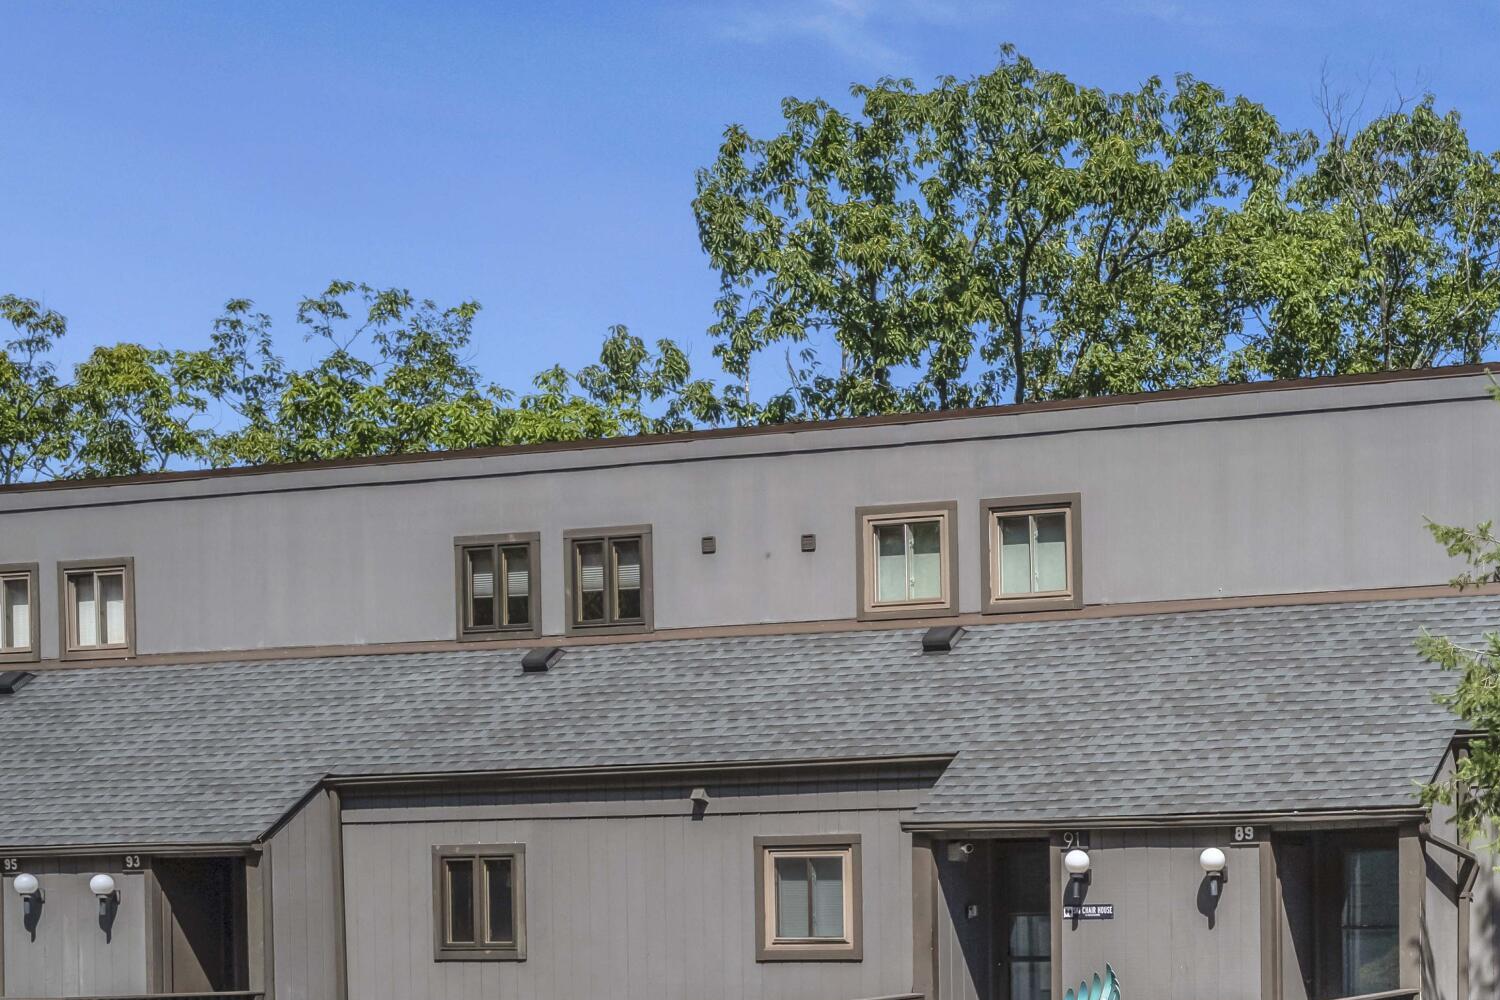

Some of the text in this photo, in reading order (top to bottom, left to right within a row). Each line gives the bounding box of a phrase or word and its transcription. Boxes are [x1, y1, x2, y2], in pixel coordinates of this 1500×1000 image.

[1063, 831, 1080, 849] 91
[1234, 826, 1254, 841] 89
[4, 858, 18, 870] 95
[125, 855, 141, 868] 93
[1081, 906, 1097, 914] CHAIR
[1097, 906, 1113, 914] HOUSE
